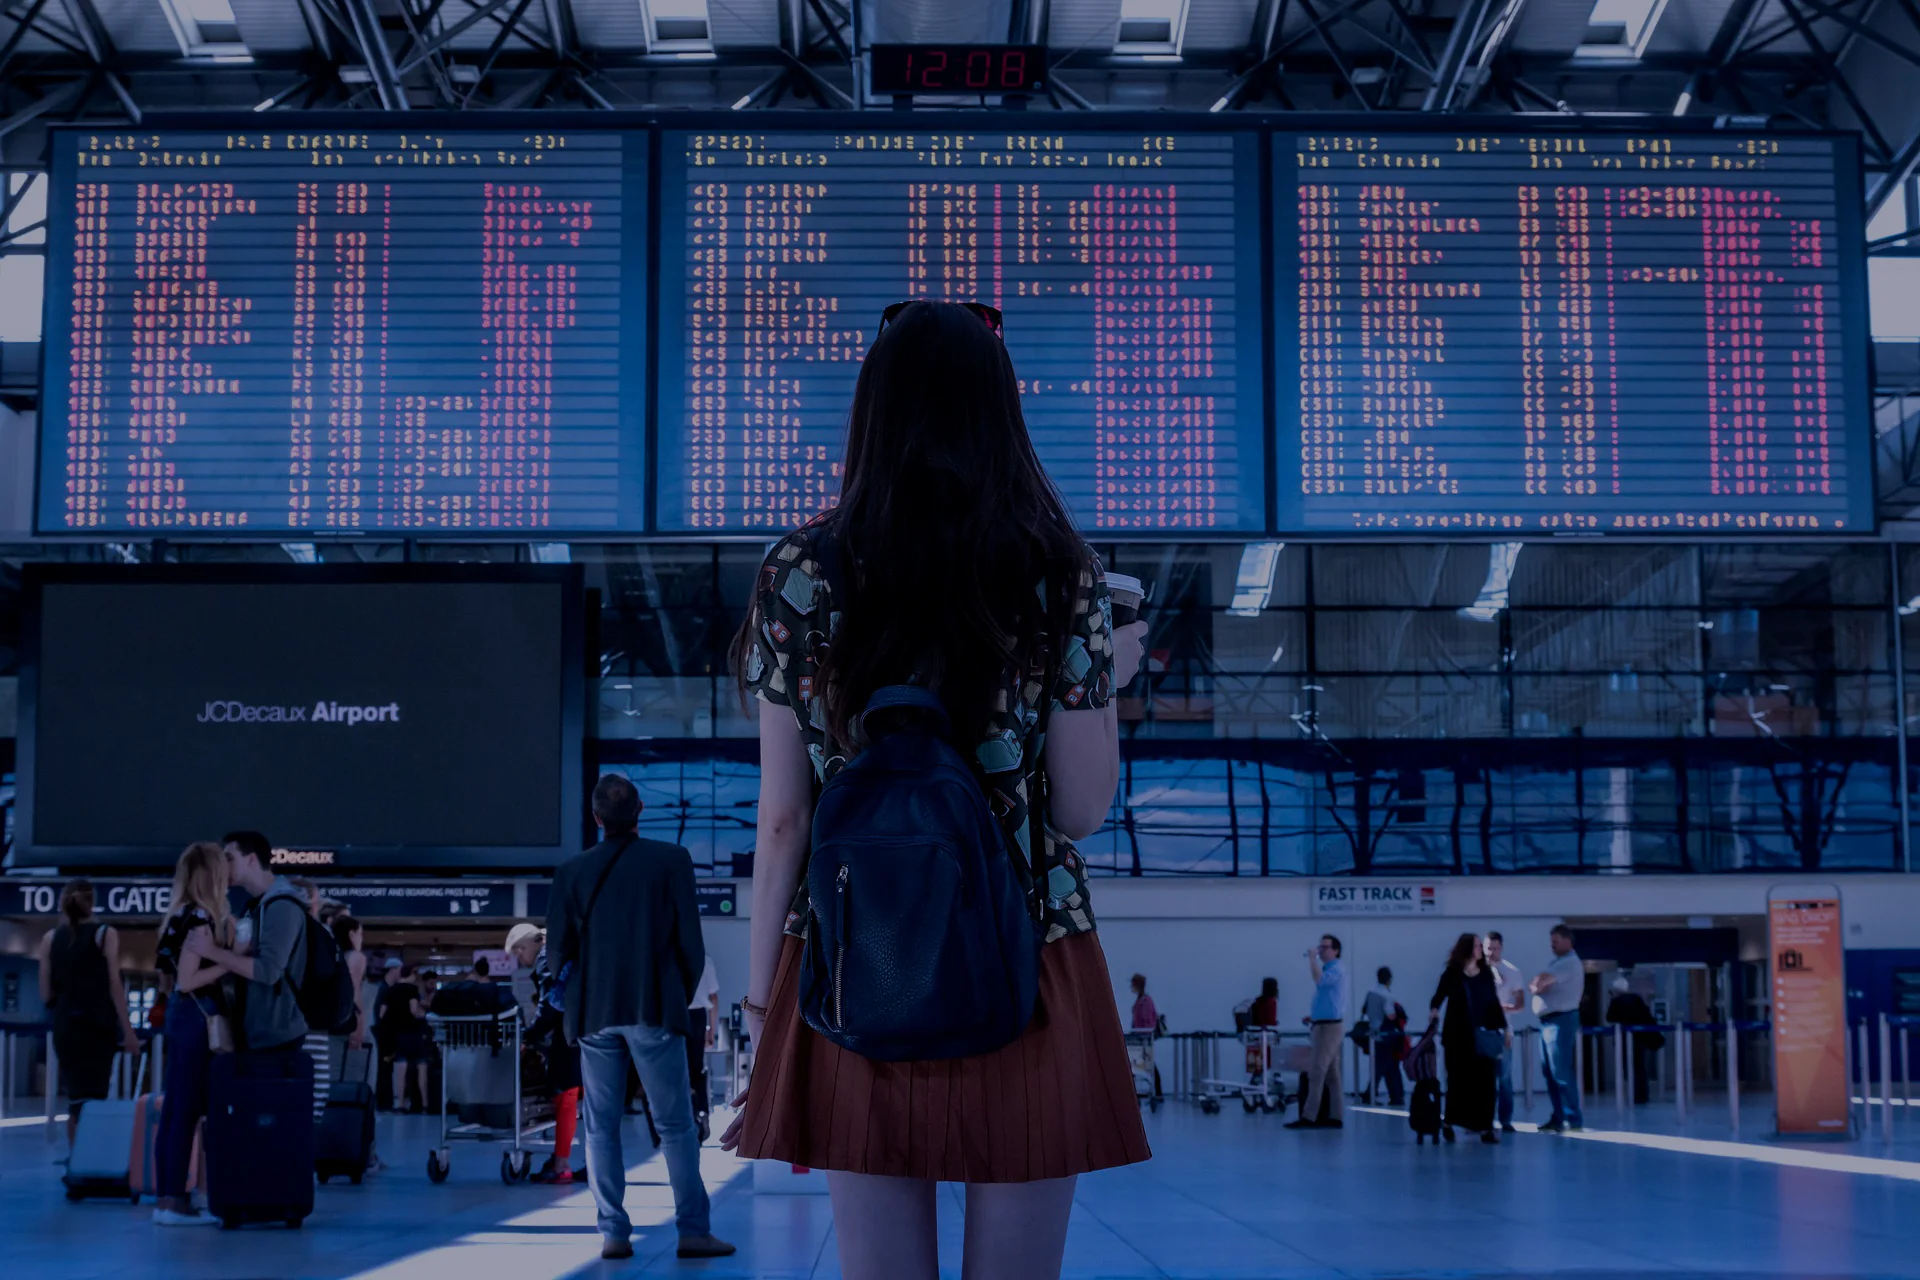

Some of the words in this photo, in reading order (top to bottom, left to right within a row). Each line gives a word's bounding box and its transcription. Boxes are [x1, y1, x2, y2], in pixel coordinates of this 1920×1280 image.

[904, 50, 1026, 88] 12:08
[196, 700, 306, 722] JCDecaux
[311, 701, 400, 726] Airport
[269, 848, 335, 864] Decaux
[19, 886, 55, 912] TO
[108, 886, 172, 913] GATE
[328, 887, 348, 897] YOUR
[348, 887, 387, 897] PASSPORT
[387, 887, 405, 897] AND
[405, 887, 444, 897] BOARDING
[444, 887, 463, 897] PASS
[464, 887, 490, 897] READY
[1319, 887, 1356, 900] FAST
[1362, 887, 1411, 900] TRACK
